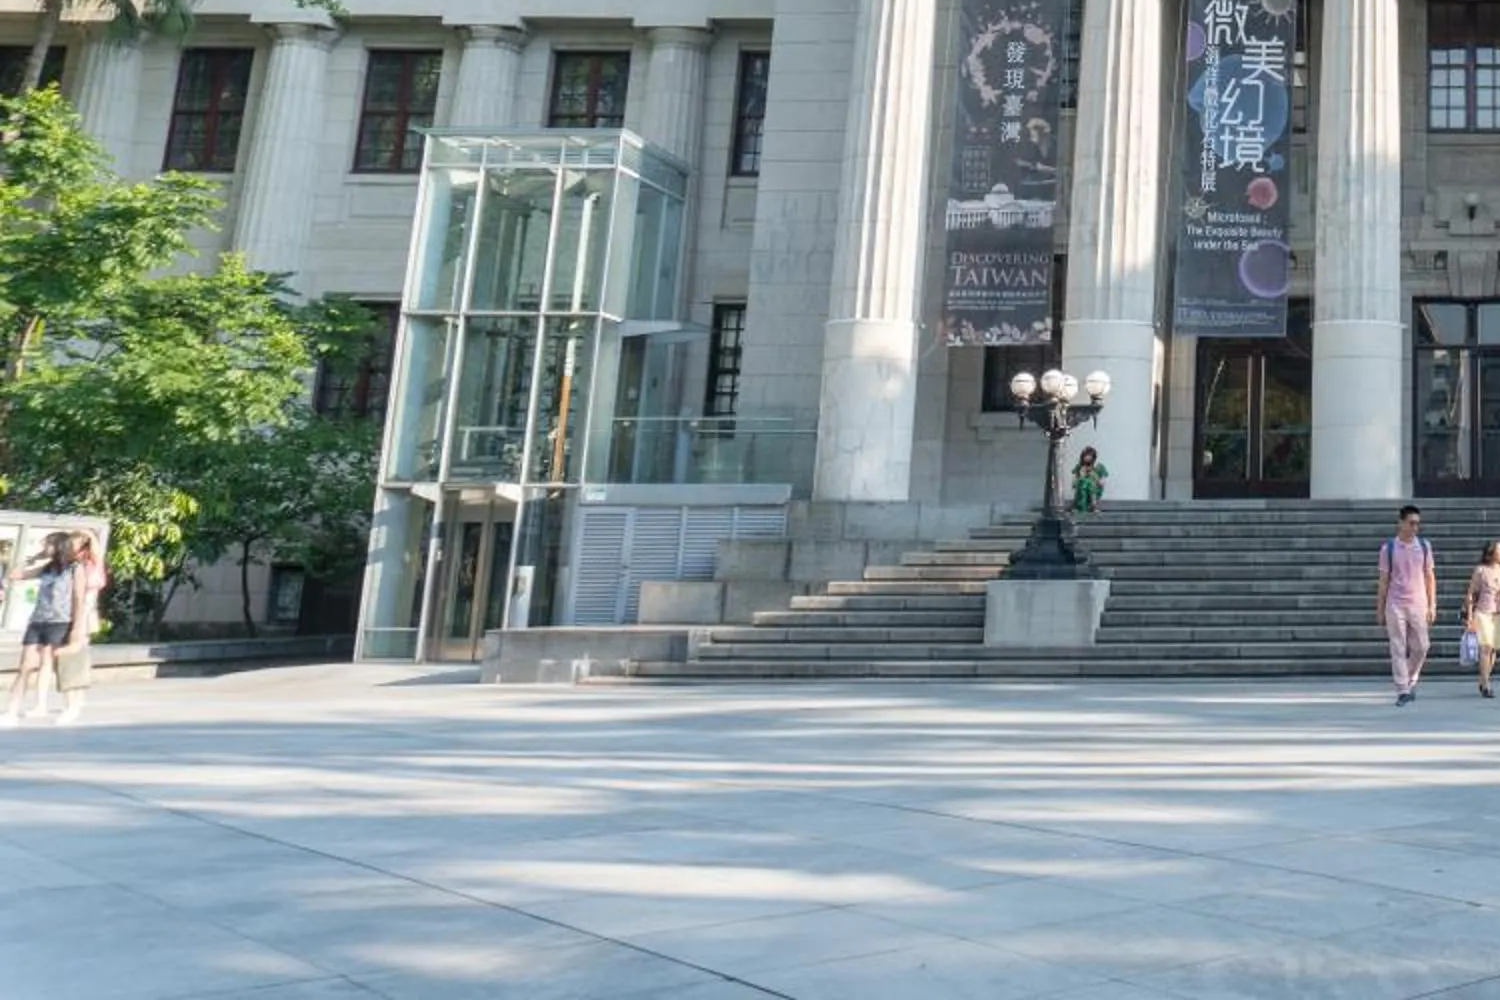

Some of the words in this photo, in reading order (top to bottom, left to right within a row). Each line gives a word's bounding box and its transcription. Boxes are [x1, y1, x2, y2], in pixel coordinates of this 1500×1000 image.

[1001, 41, 1026, 143] 發現臺灣
[1186, 225, 1203, 236] The
[950, 265, 1049, 288] TAIWAN
